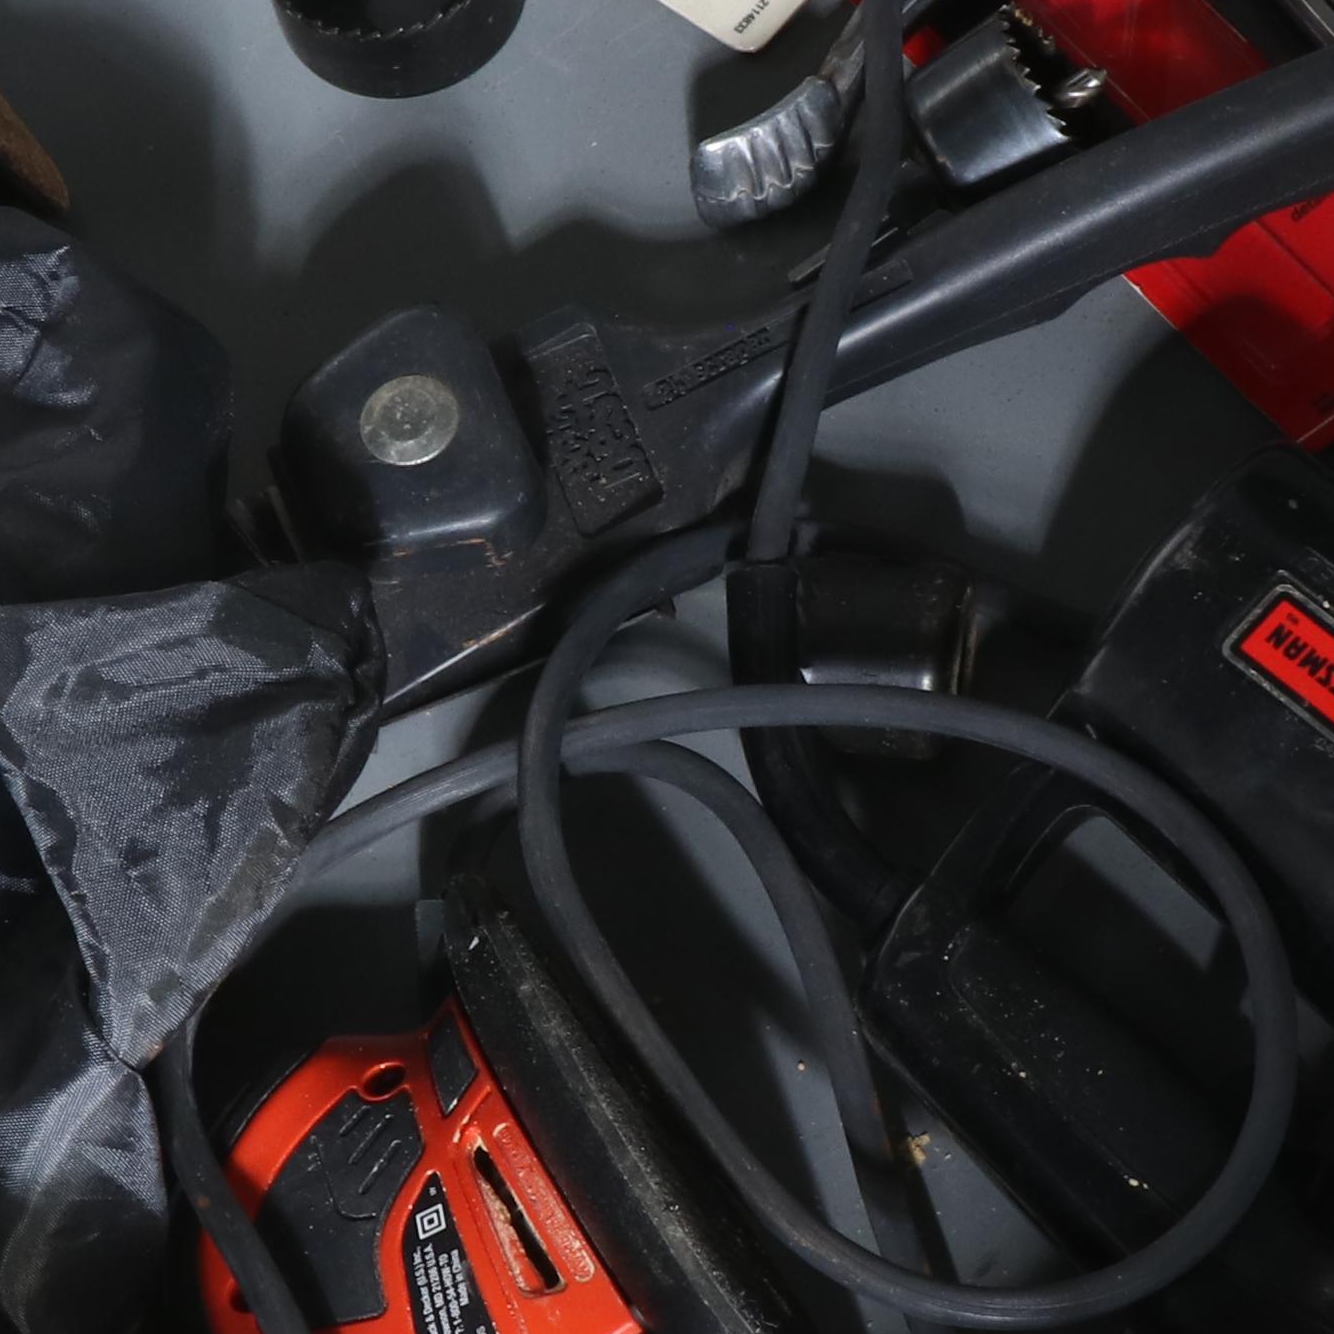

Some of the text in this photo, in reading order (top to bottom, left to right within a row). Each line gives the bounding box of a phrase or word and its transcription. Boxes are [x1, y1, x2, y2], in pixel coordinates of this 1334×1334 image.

[449, 1249, 469, 1305] Made in China
[419, 1286, 433, 1314] Decker
[433, 1292, 445, 1306] MD
[425, 1314, 434, 1322] &
